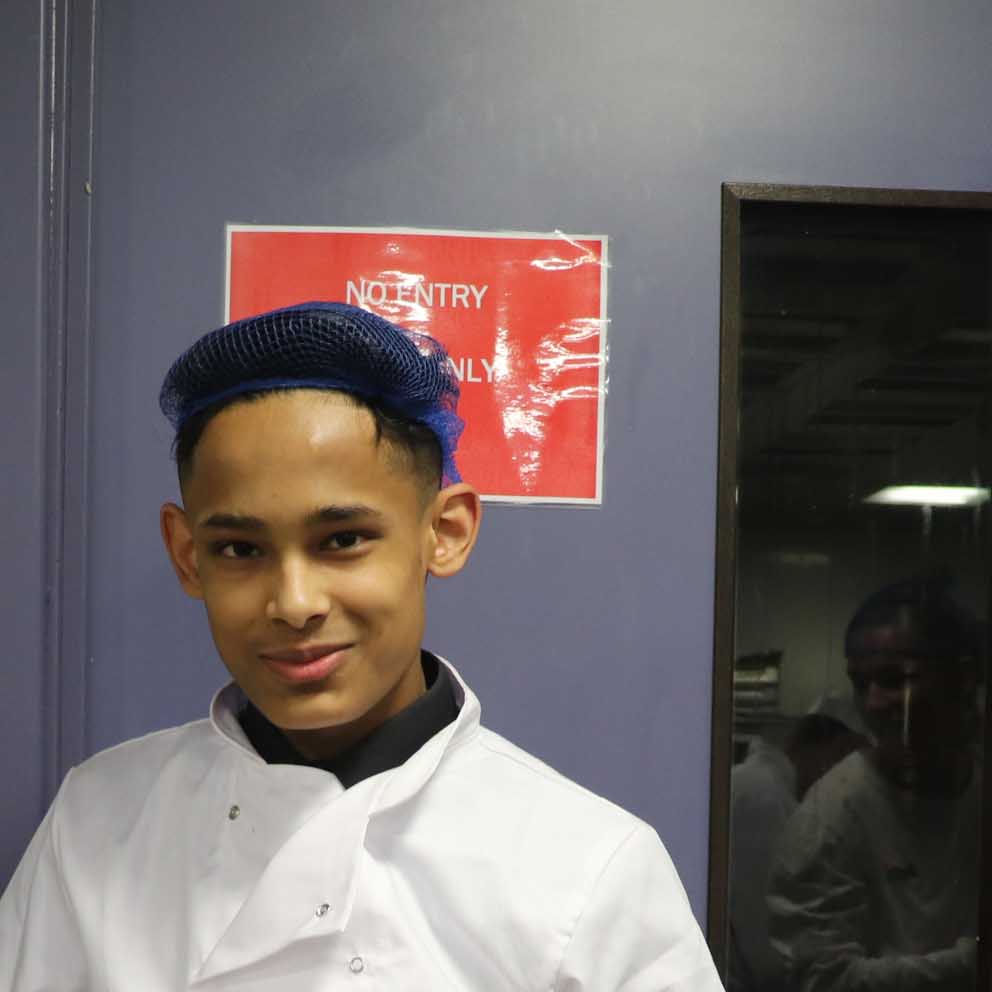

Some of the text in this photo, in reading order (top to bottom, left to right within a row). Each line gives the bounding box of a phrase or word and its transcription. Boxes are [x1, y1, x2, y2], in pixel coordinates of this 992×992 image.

[346, 280, 489, 309] NO ENTRY
[441, 357, 499, 383] NLY
